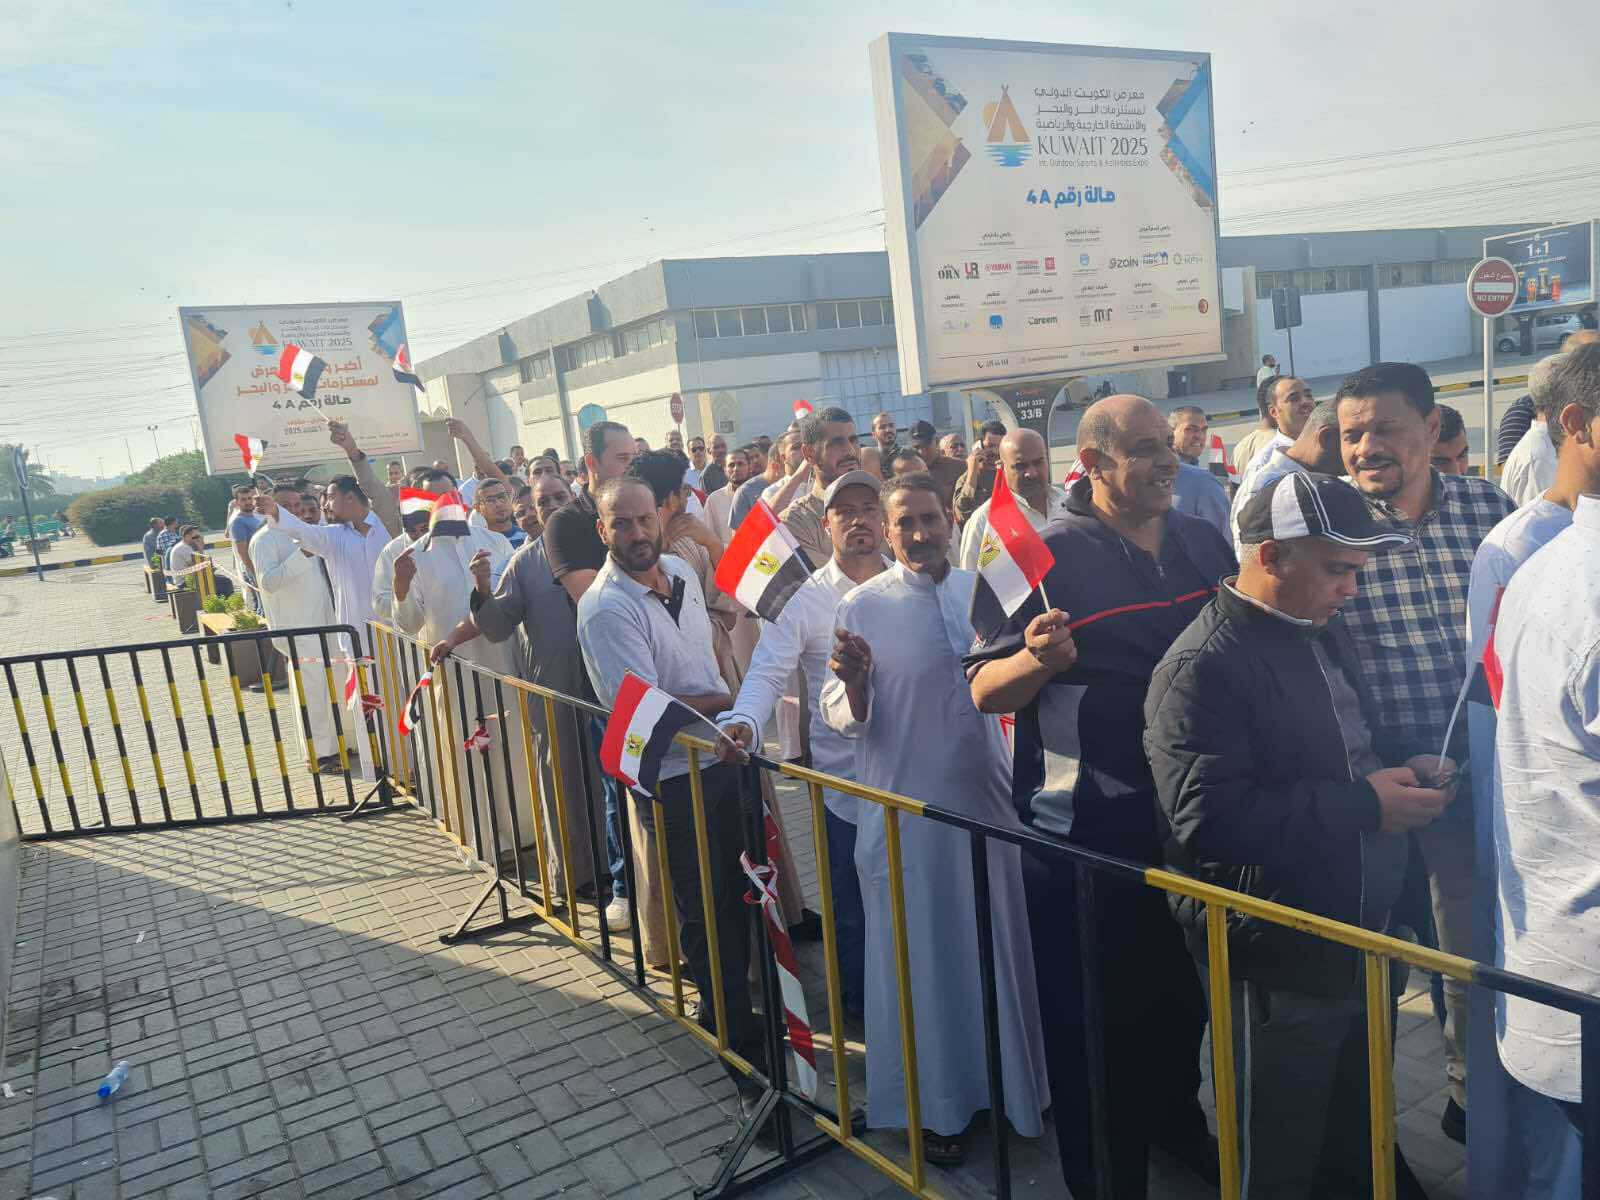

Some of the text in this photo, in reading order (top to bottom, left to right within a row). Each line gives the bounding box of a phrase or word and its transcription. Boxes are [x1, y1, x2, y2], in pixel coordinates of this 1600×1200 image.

[1034, 87, 1072, 99] الدولي
[1074, 87, 1111, 100] الكويت
[1037, 135, 1149, 156] KUWAIT 2025
[1054, 186, 1082, 208] رقم
[1085, 185, 1116, 203] صالة
[1020, 407, 1043, 421] 33/B
